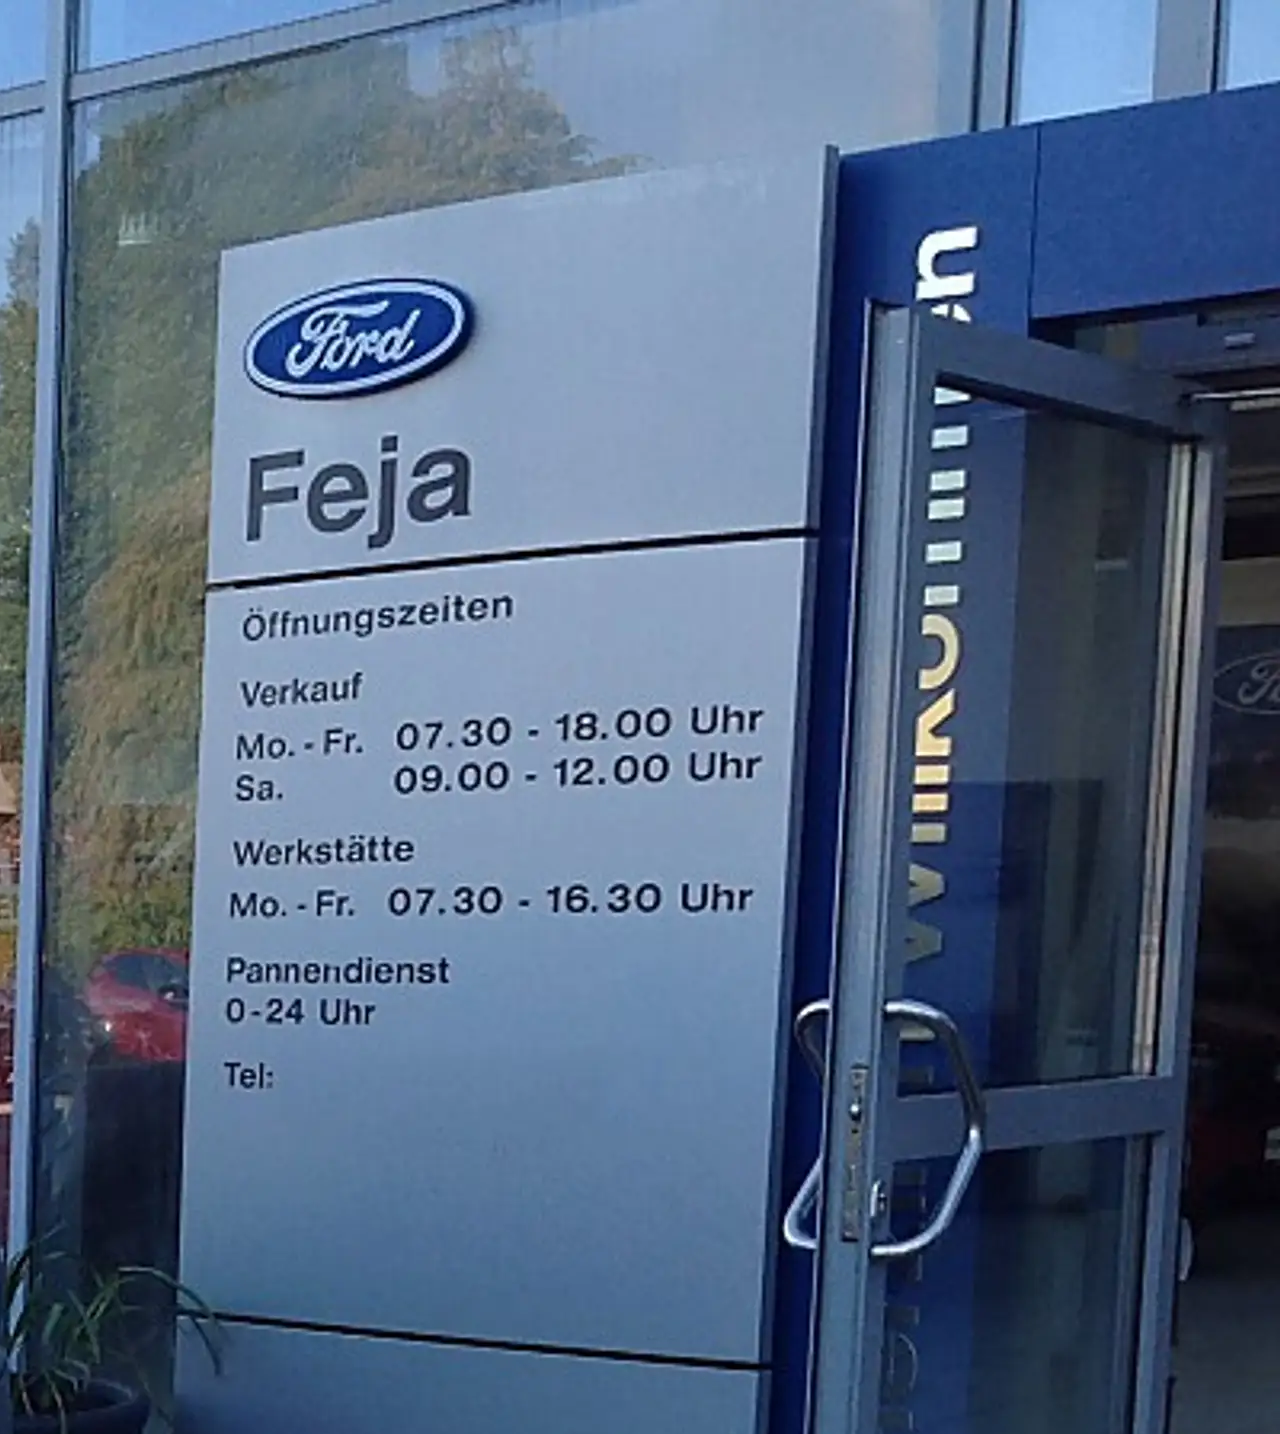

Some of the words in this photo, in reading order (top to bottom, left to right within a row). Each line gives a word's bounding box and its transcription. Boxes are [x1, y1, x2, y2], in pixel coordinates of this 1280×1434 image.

[284, 299, 422, 378] Ford
[246, 435, 471, 550] Feja
[243, 595, 513, 642] Öffnungszeiten
[241, 671, 363, 708] Verkauf
[236, 733, 295, 760] Mo.
[323, 727, 363, 755] Fr.
[396, 716, 512, 751] 07.30
[555, 707, 672, 742] 18.00
[691, 704, 764, 735] Uhr
[235, 774, 283, 802] Sa.
[394, 761, 510, 795] 09.00
[553, 753, 670, 787] 12.00
[689, 751, 763, 782] Uhr
[233, 834, 415, 867] Werkstätte
[230, 892, 287, 918] Mo.
[316, 889, 355, 917] Fr.
[388, 886, 503, 917] 07.30
[546, 883, 662, 914] 16.30
[681, 883, 754, 913] Uhr
[226, 956, 450, 985] Pannendienst
[226, 997, 305, 1025] 0-24
[320, 998, 376, 1026] Uhr
[223, 1061, 273, 1089] Tel:
